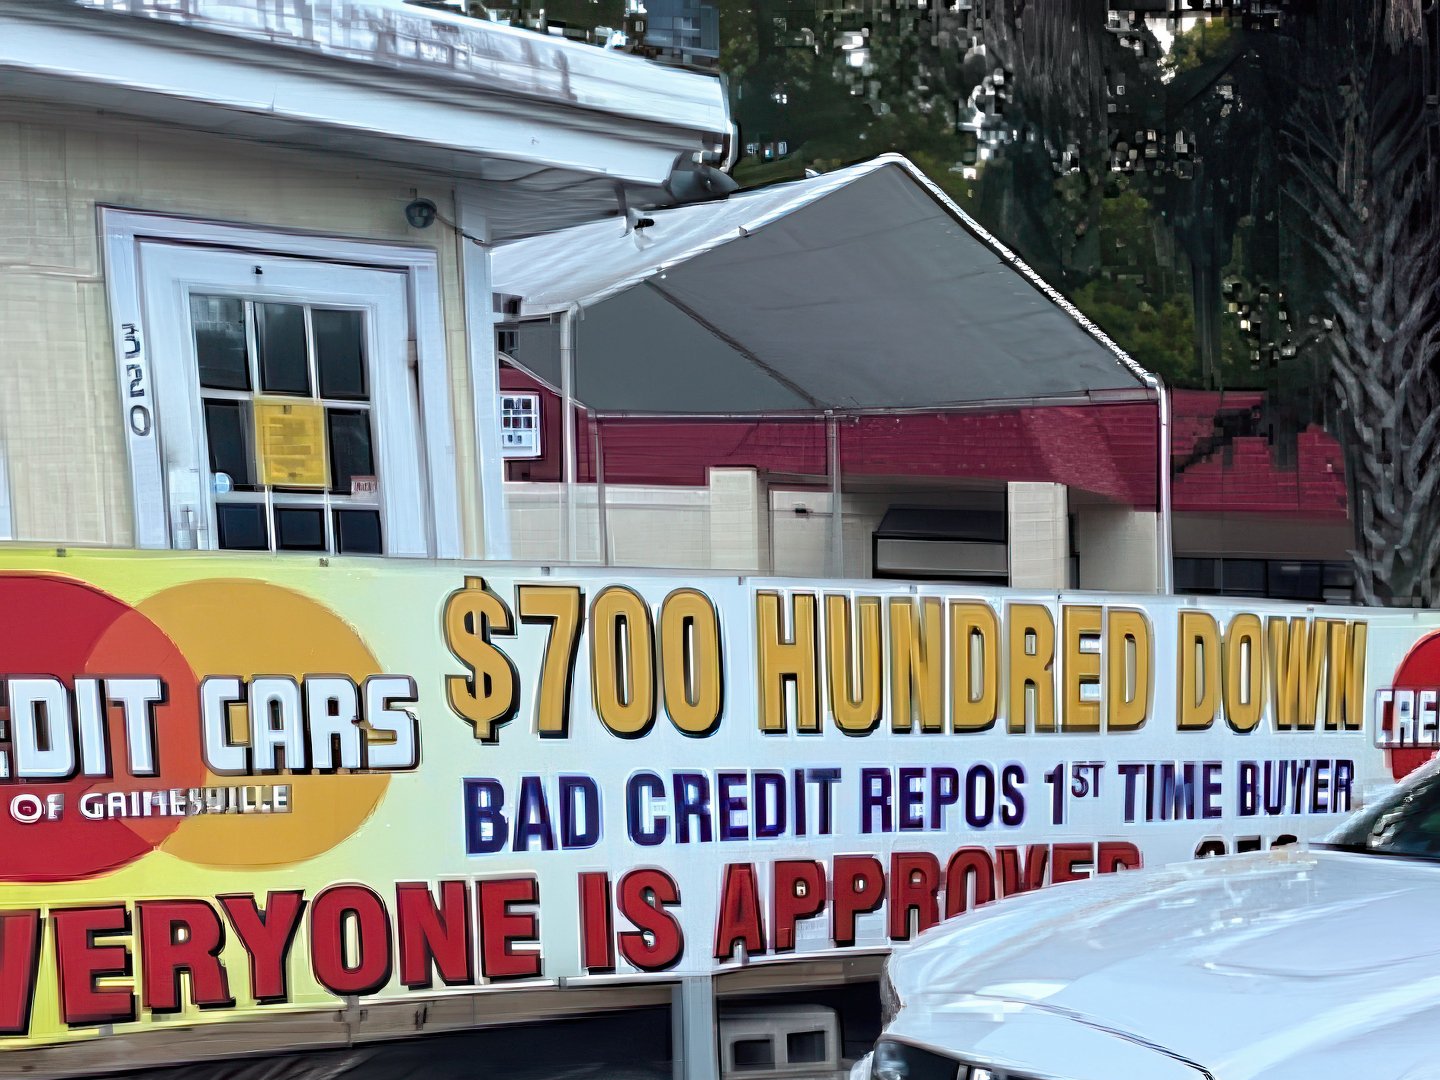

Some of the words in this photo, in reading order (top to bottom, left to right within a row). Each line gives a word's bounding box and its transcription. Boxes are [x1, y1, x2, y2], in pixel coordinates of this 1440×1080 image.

[121, 322, 151, 437] 320
[443, 576, 724, 745] $700
[757, 590, 1154, 738] HUNDRED
[1178, 610, 1367, 734] DOWN
[200, 673, 422, 776] CARS
[10, 792, 64, 824] OF
[463, 774, 600, 854] BAD
[626, 768, 842, 846] CREDIT
[861, 763, 1026, 833] REPOS
[1044, 760, 1106, 825] 1ST
[1118, 760, 1223, 823] TIME
[1238, 759, 1355, 817] BUYER
[579, 866, 685, 972] IS
